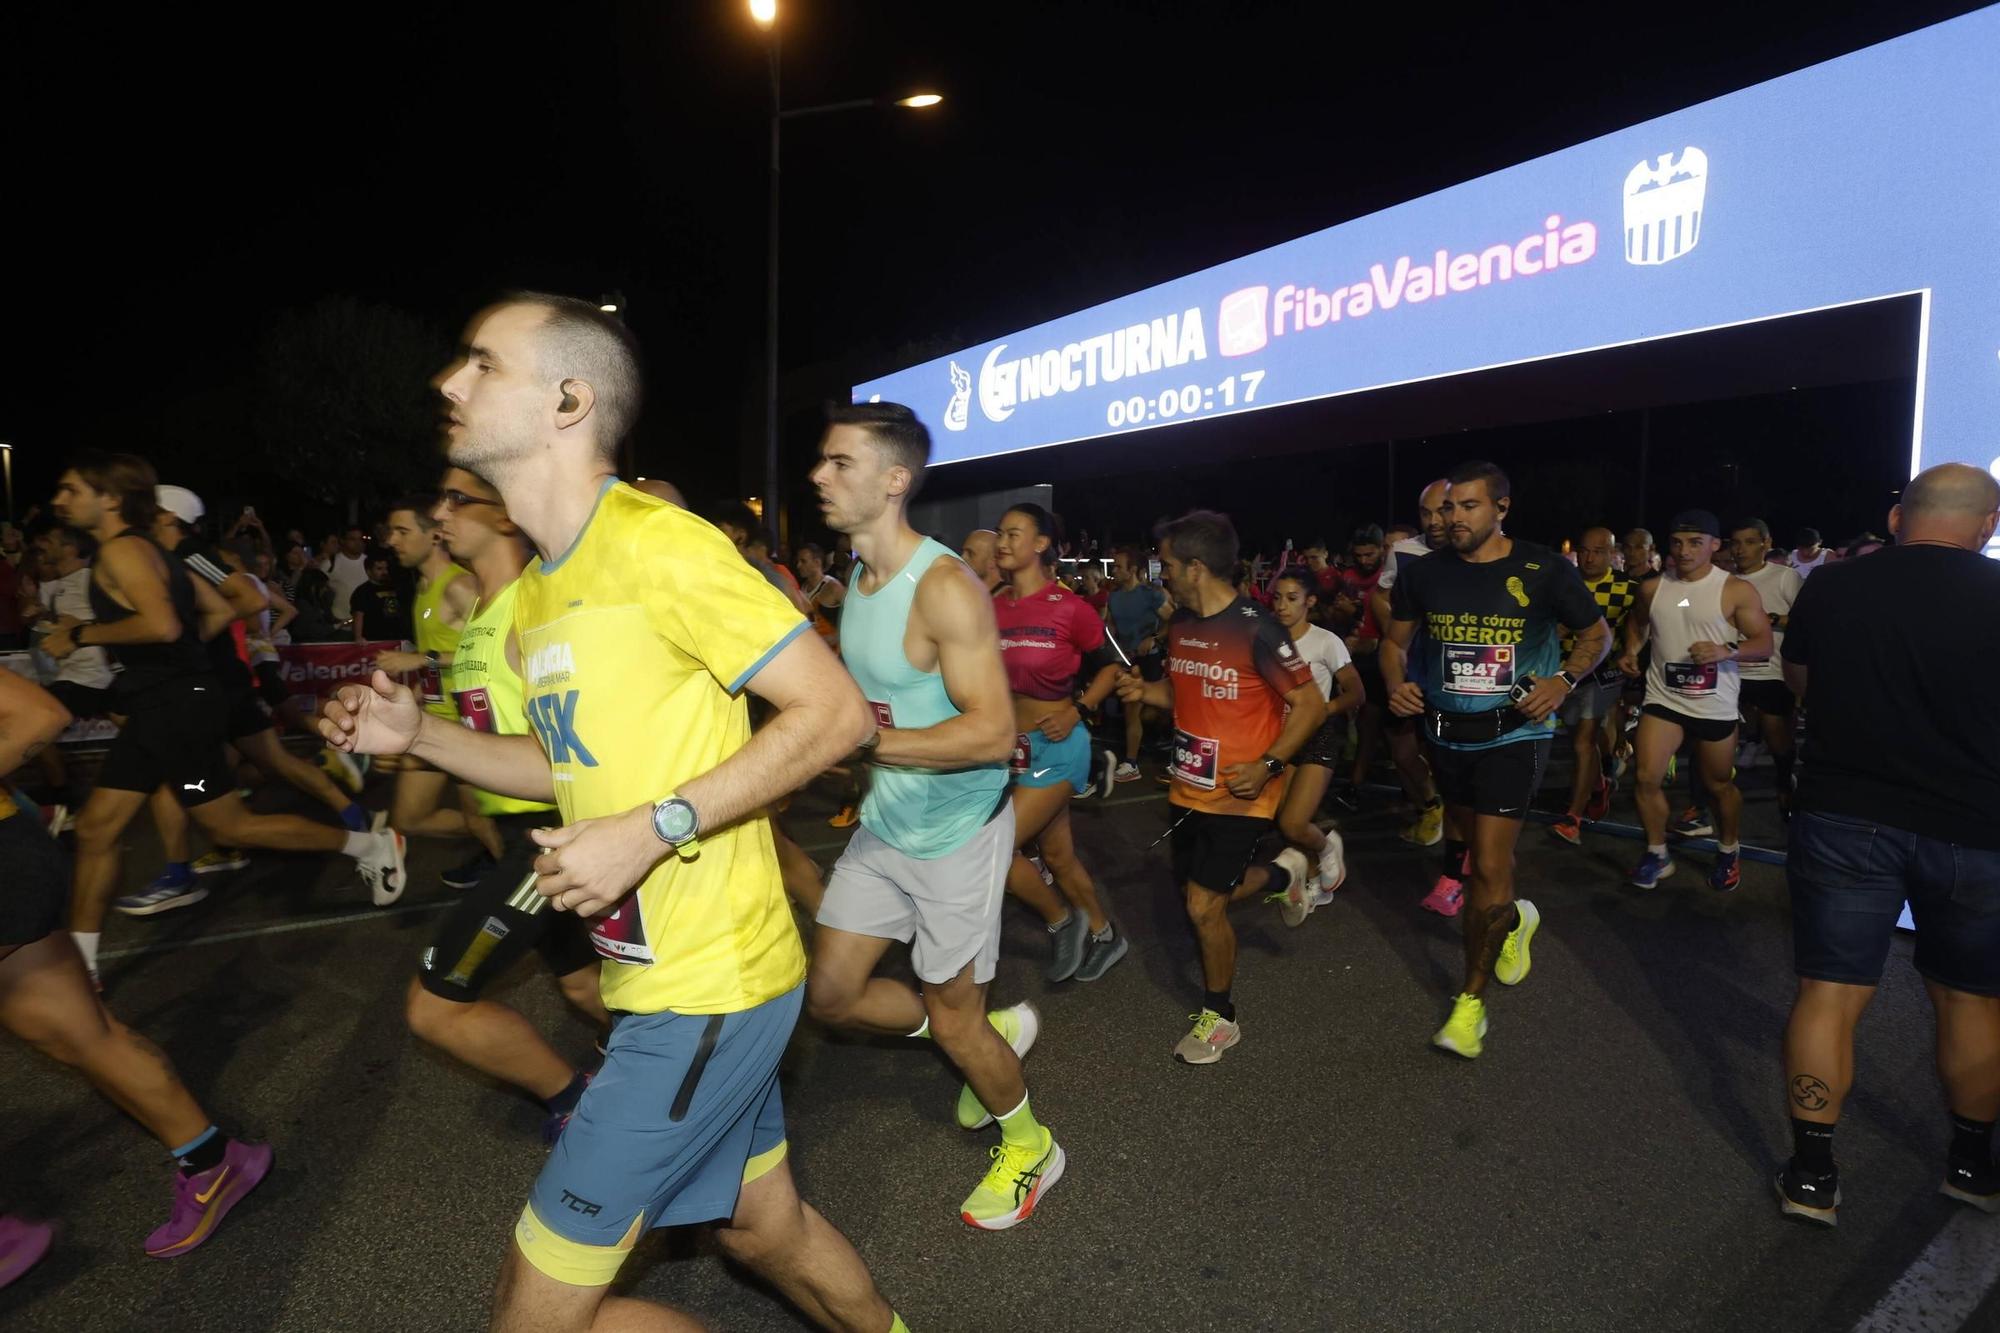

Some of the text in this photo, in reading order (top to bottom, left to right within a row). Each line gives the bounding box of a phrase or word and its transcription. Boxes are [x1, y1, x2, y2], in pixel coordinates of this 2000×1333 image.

[1273, 214, 1597, 336] fibraValencia
[1021, 306, 1208, 403] NOCTURNA
[1107, 369, 1266, 428] 00:00:17
[1460, 612, 1478, 624] de
[1482, 614, 1527, 627] córrer
[1427, 625, 1524, 645] MUSEROS
[1170, 656, 1238, 682] orremón
[1451, 661, 1501, 676] 9847
[1676, 674, 1705, 685] 940
[1203, 678, 1238, 700] trail
